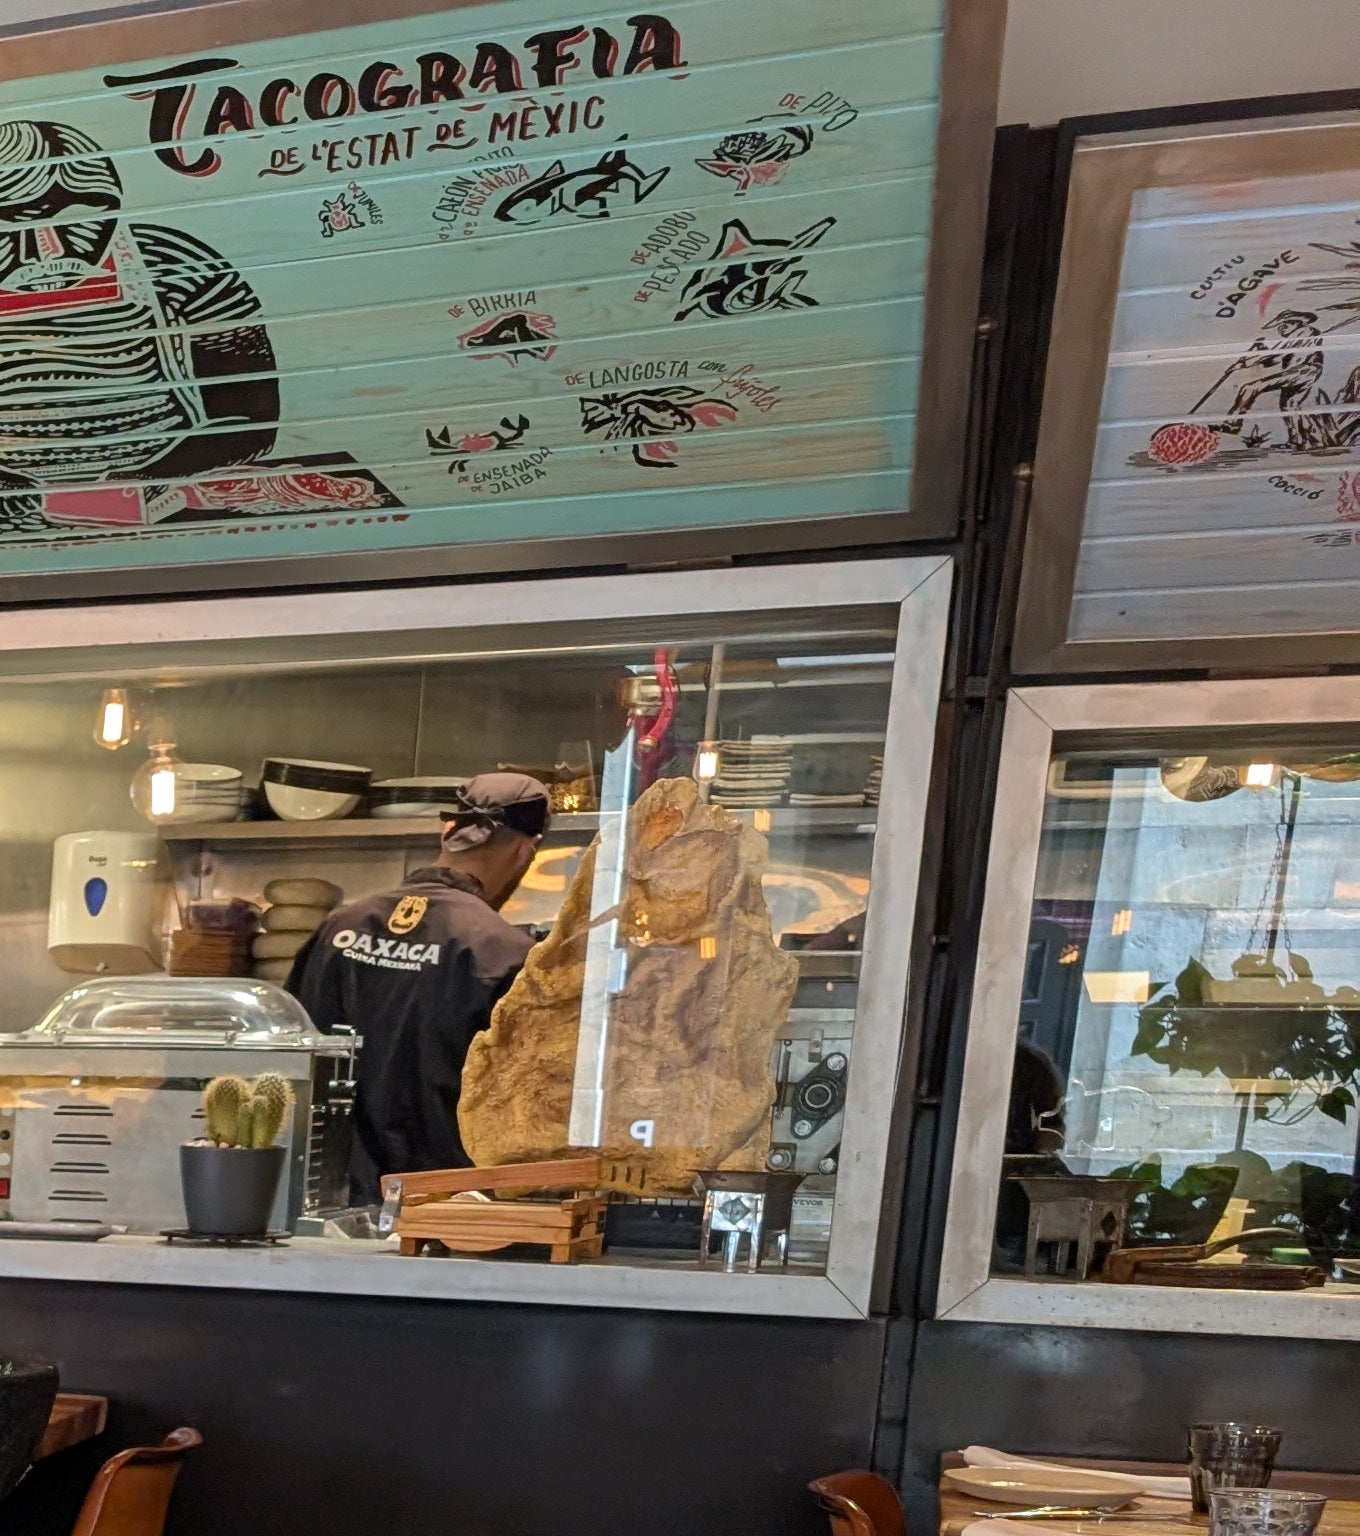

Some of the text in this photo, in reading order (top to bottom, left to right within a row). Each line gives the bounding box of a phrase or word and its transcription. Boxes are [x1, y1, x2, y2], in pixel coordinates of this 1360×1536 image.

[103, 14, 689, 178] TACOGRAFIA
[778, 90, 859, 132] DE PITO
[264, 148, 304, 175] DE
[312, 126, 422, 173] L'ESTAT
[431, 119, 471, 149] DE
[461, 163, 530, 217] ENSENADA
[630, 249, 651, 265] DE
[633, 230, 710, 303] DE PESCADO
[447, 304, 465, 319] DE
[565, 374, 585, 387] DE
[588, 360, 690, 389] LANGOSTA
[473, 445, 554, 484] ENSENADA
[490, 469, 547, 495] JAIBA
[332, 929, 441, 965] OAXACA
